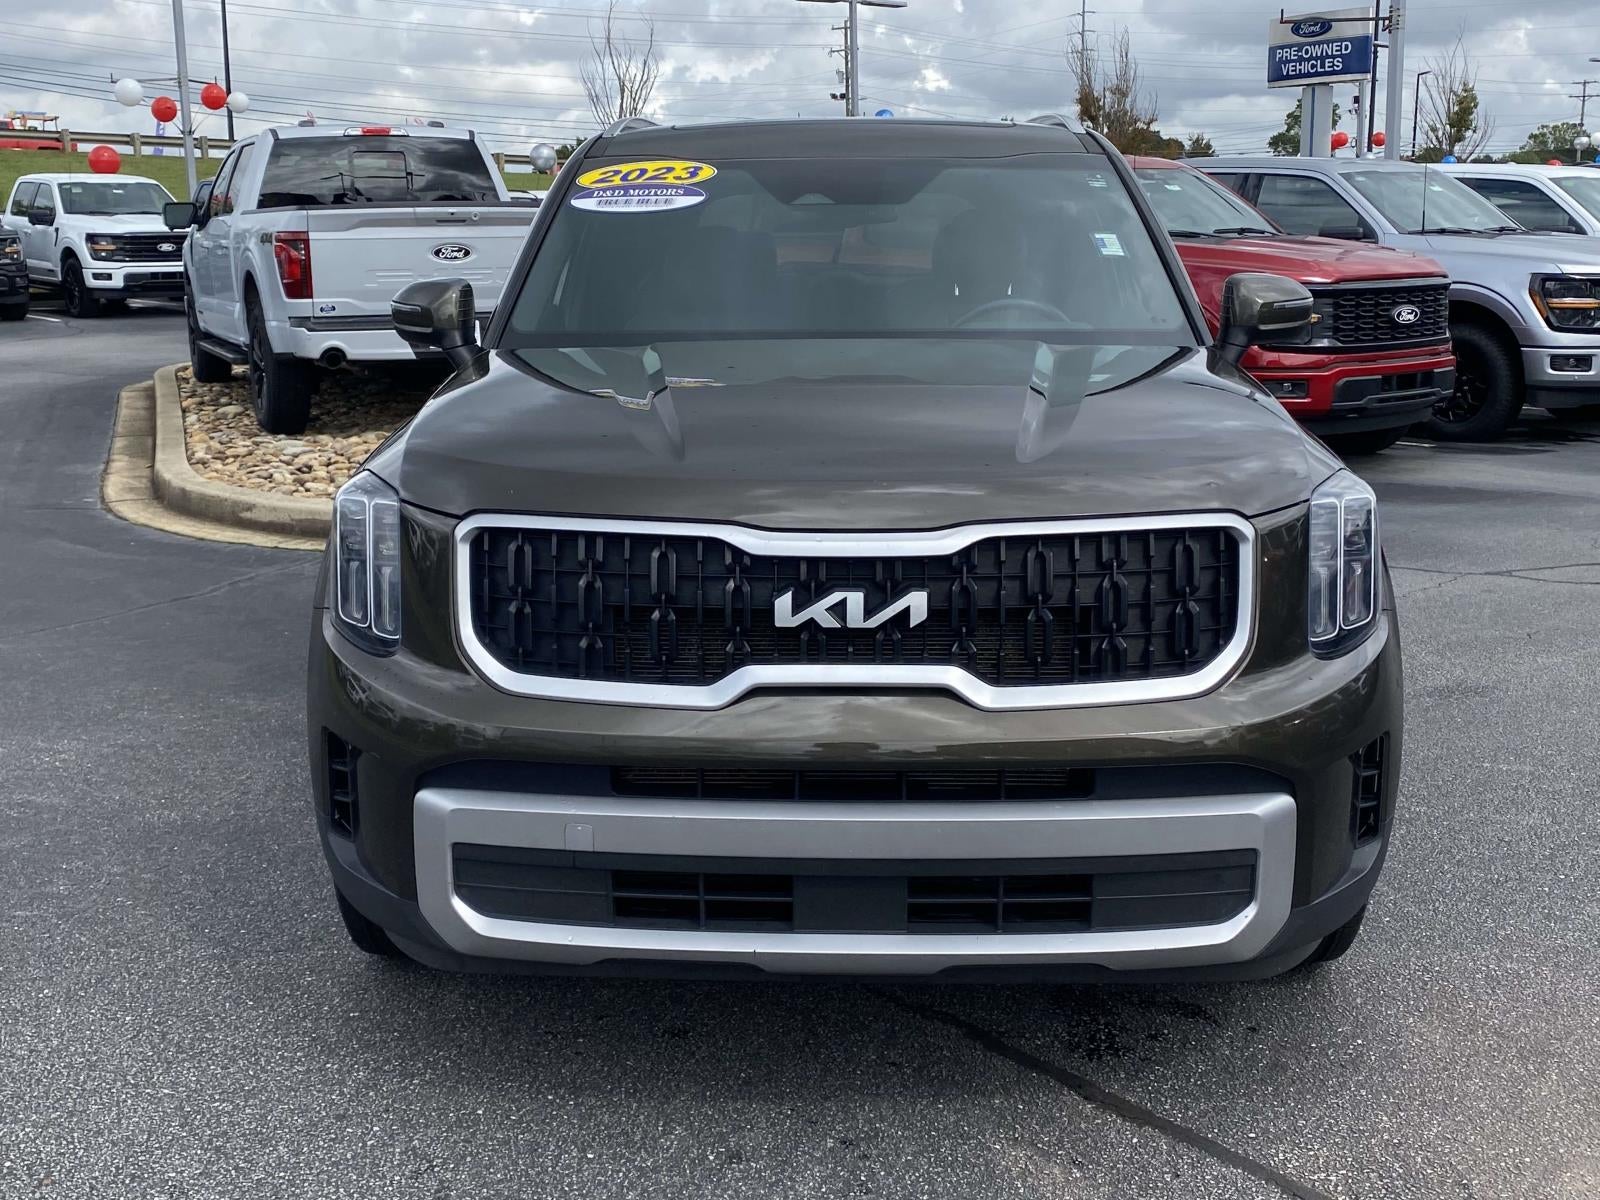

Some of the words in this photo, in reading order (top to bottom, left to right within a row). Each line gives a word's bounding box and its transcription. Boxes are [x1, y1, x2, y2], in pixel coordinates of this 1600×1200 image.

[1299, 21, 1321, 34] Ford
[1276, 41, 1352, 62] PRE-OWNED
[1281, 58, 1343, 76] VEHICLES
[589, 166, 704, 184] 2023
[592, 190, 624, 198] D&D
[627, 188, 685, 196] MOTORS
[774, 590, 928, 629] KIA
